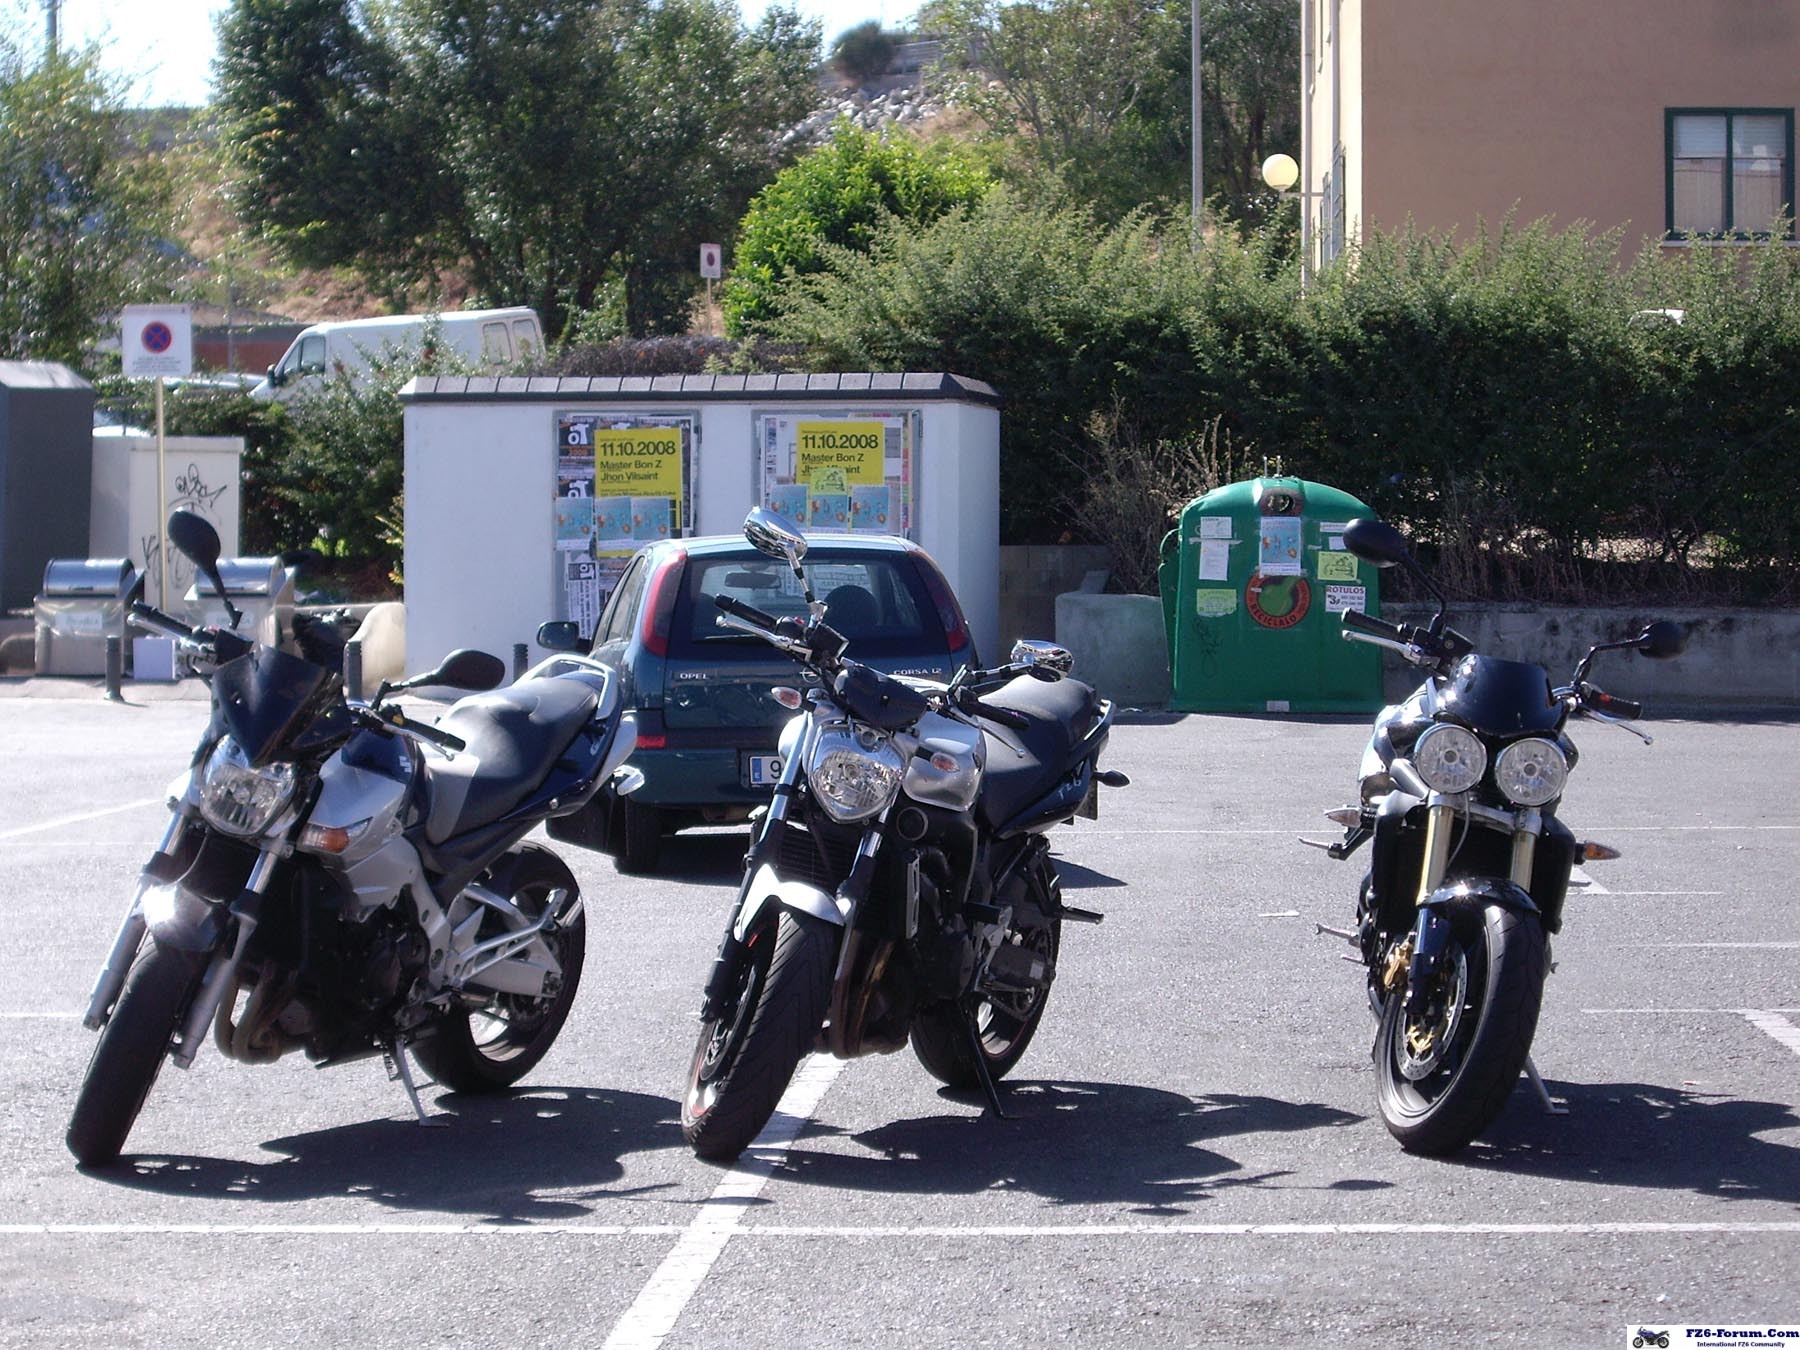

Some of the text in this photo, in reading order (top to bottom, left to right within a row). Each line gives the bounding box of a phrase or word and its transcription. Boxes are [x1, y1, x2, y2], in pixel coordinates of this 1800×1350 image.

[802, 433, 879, 449] 11.10.2008
[600, 441, 676, 456] 11.10.2008
[801, 453, 865, 462] Master Bon Z
[600, 461, 632, 469] Master
[634, 461, 653, 469] Bon
[655, 460, 662, 468] Z
[601, 472, 624, 481] Jhon
[680, 672, 710, 680] OPEL
